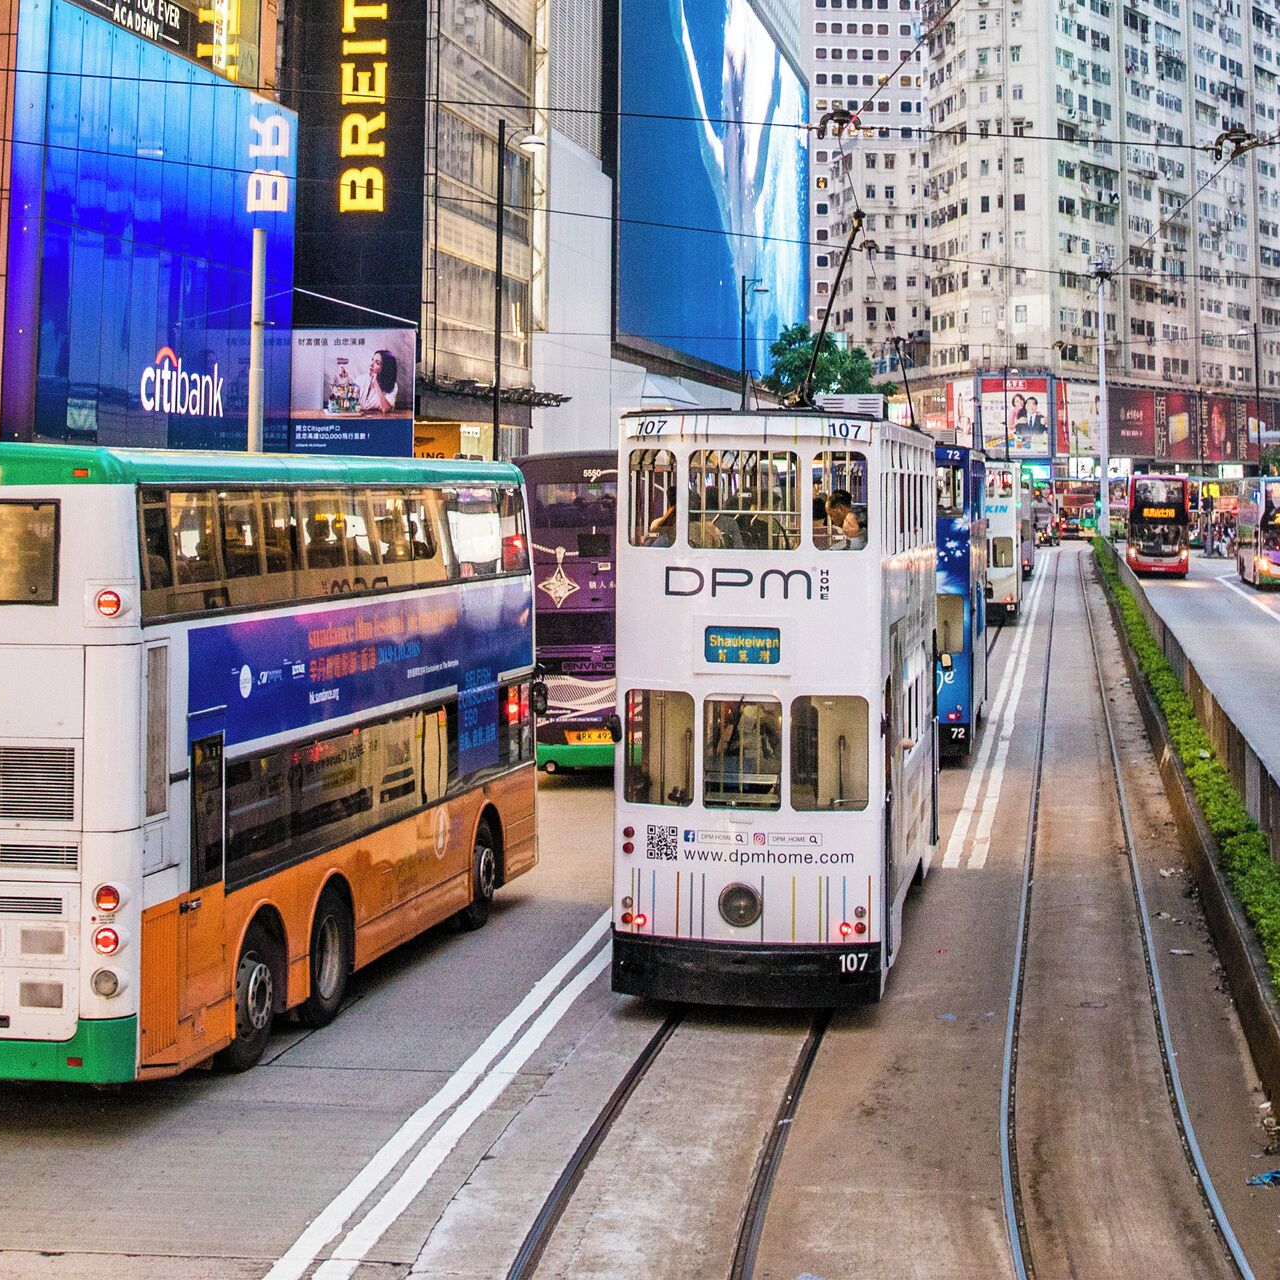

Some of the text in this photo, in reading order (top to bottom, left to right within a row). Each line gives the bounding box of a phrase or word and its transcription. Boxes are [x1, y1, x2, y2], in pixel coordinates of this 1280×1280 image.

[113, 3, 160, 41] ACADEMY
[158, 0, 180, 30] EVER
[140, 348, 224, 418] citibank
[635, 420, 668, 435] 107
[828, 423, 862, 440] 107
[947, 450, 960, 460] 72
[583, 469, 602, 478] 5550
[664, 565, 812, 600] DPM
[820, 569, 829, 601] HOME
[710, 634, 780, 648] Shaukeiwan
[951, 728, 965, 739] 72
[715, 834, 732, 842] HOME
[772, 835, 806, 843] DPM_HOME
[683, 848, 855, 866] www.dpmhome.com
[838, 952, 869, 973] 107
